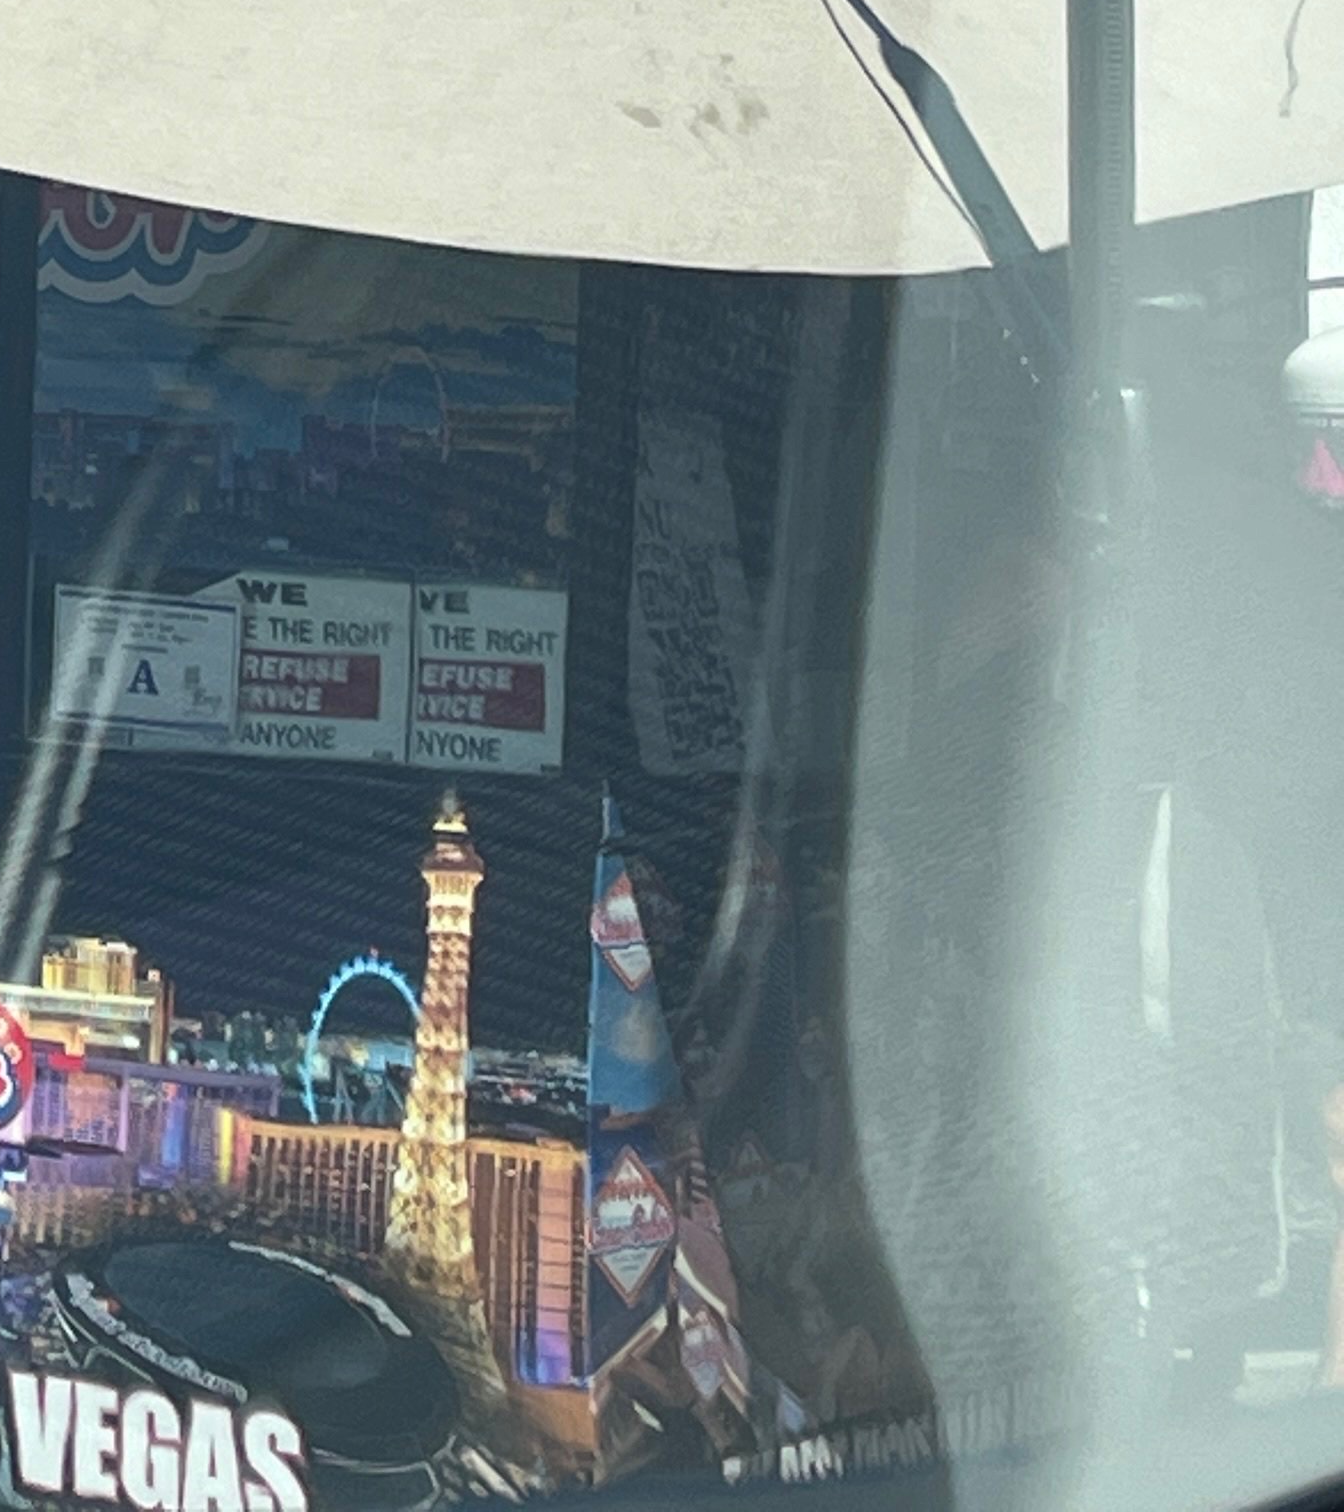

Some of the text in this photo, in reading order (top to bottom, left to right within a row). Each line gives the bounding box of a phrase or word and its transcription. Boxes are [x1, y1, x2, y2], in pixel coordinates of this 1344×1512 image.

[236, 578, 308, 607] WE
[267, 616, 314, 644] THE
[322, 620, 393, 648] RIGHT
[428, 624, 561, 658] THE RIGHT
[127, 658, 160, 696] A
[242, 654, 350, 685] REFUSE
[421, 664, 515, 692] EFUSE
[239, 722, 338, 750] ANYONE
[416, 729, 503, 763] NYONE
[11, 1370, 308, 1512] VEGAS
